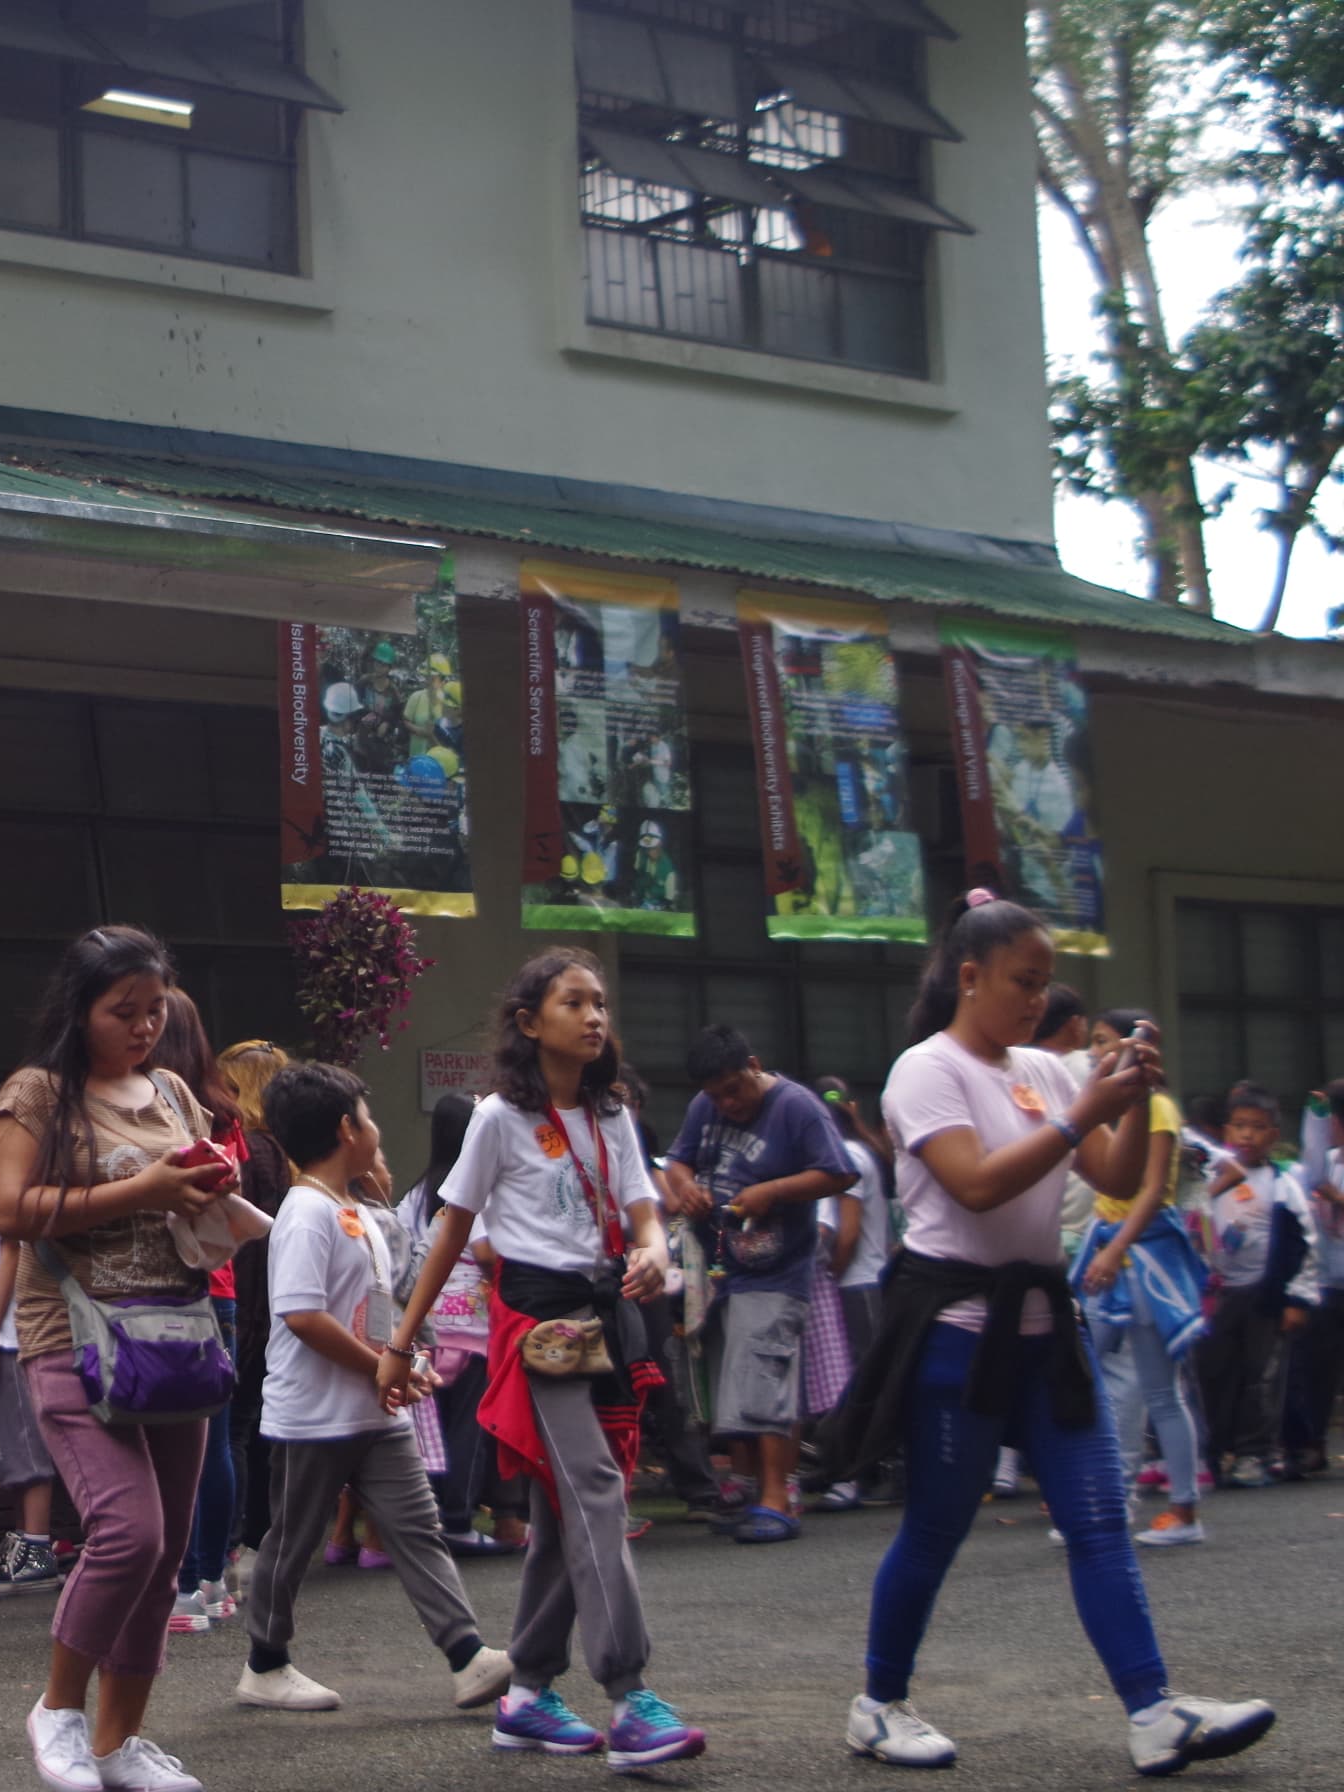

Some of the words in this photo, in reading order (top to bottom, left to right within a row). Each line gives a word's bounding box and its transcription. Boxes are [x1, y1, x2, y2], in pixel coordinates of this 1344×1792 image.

[291, 622, 304, 680] Islands
[528, 607, 541, 682] Scientific
[751, 636, 770, 709] Integrated
[291, 682, 308, 785] Biodiversity
[529, 686, 544, 755] Services
[960, 729, 976, 756] and
[759, 710, 781, 792] Biodiversity
[965, 758, 981, 800] Visits
[768, 796, 786, 850] Exhibits
[424, 1052, 489, 1070] PARKING
[427, 1071, 466, 1088] STAFF
